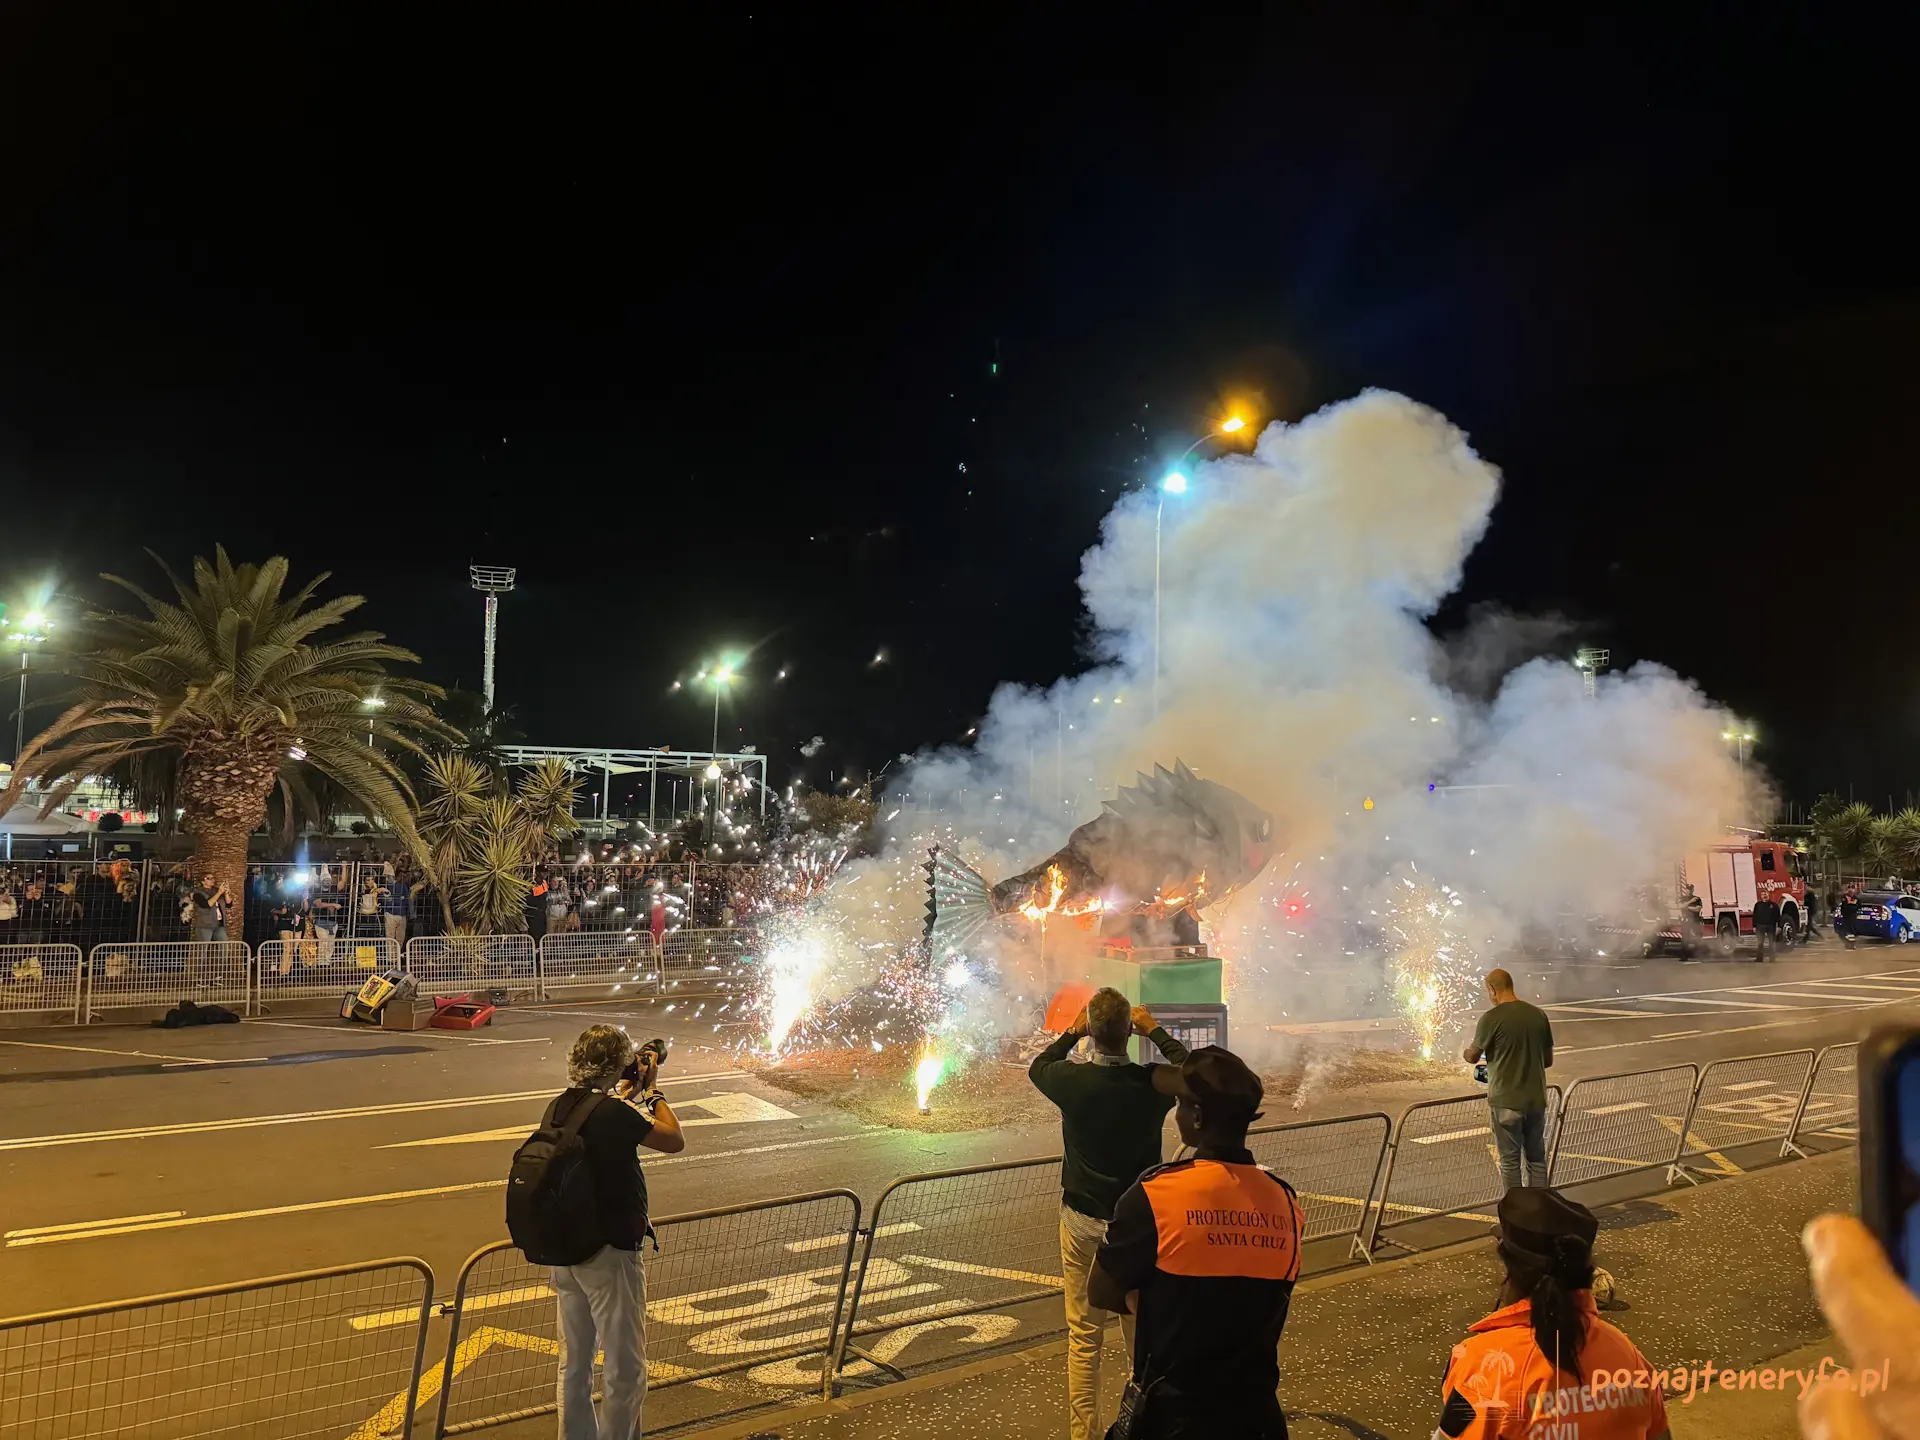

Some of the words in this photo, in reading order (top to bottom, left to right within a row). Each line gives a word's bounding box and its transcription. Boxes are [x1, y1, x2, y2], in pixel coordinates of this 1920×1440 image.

[1186, 1208, 1269, 1230] PROTECCIÓN
[1207, 1232, 1248, 1247] SANTA
[1251, 1234, 1287, 1250] CRUZ
